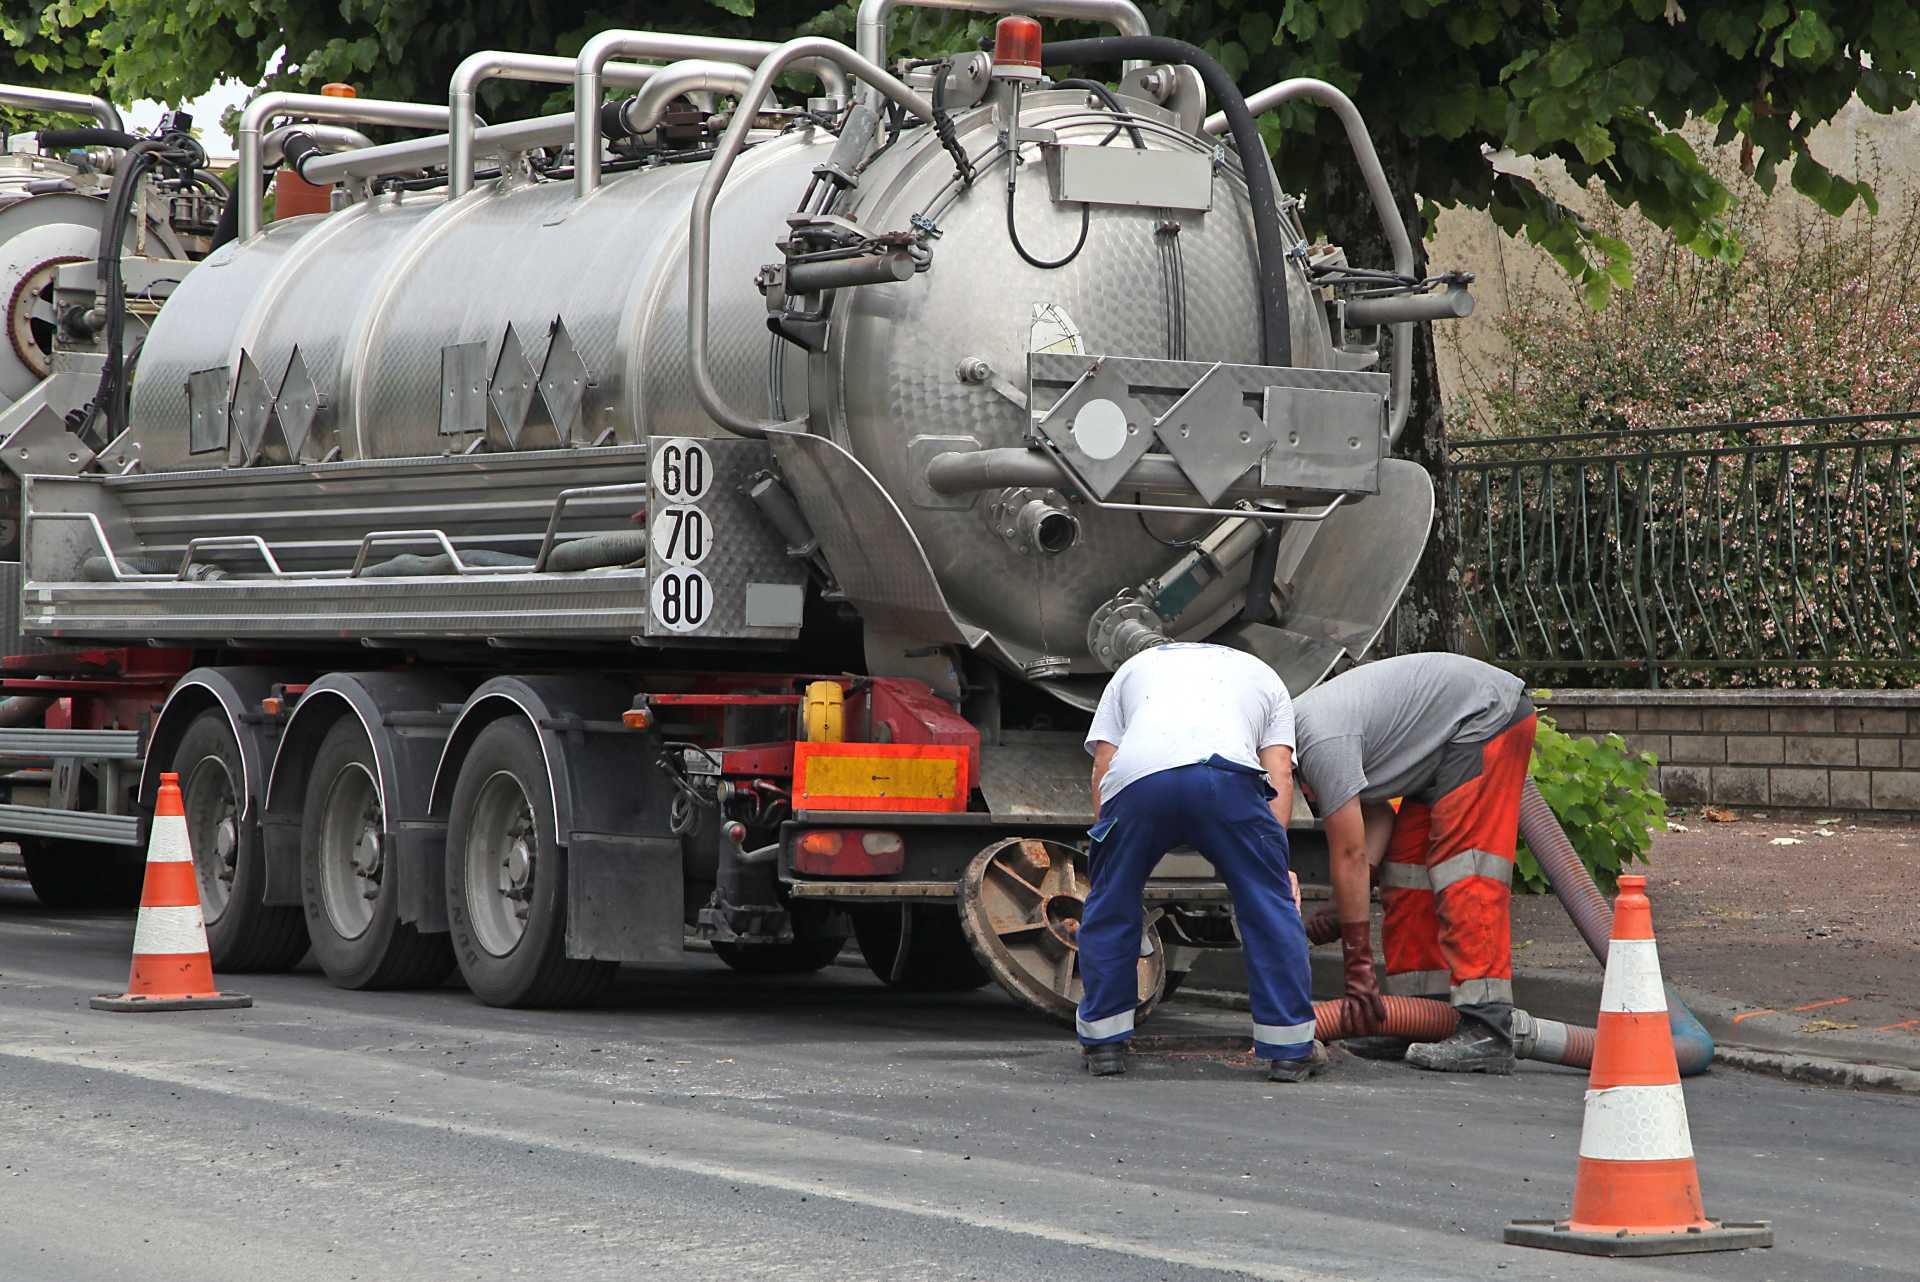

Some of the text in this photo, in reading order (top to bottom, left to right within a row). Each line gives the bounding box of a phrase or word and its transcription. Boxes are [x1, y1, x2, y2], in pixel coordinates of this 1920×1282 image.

[663, 445, 703, 497] 60
[665, 509, 703, 561] 70
[662, 573, 703, 625] 80
